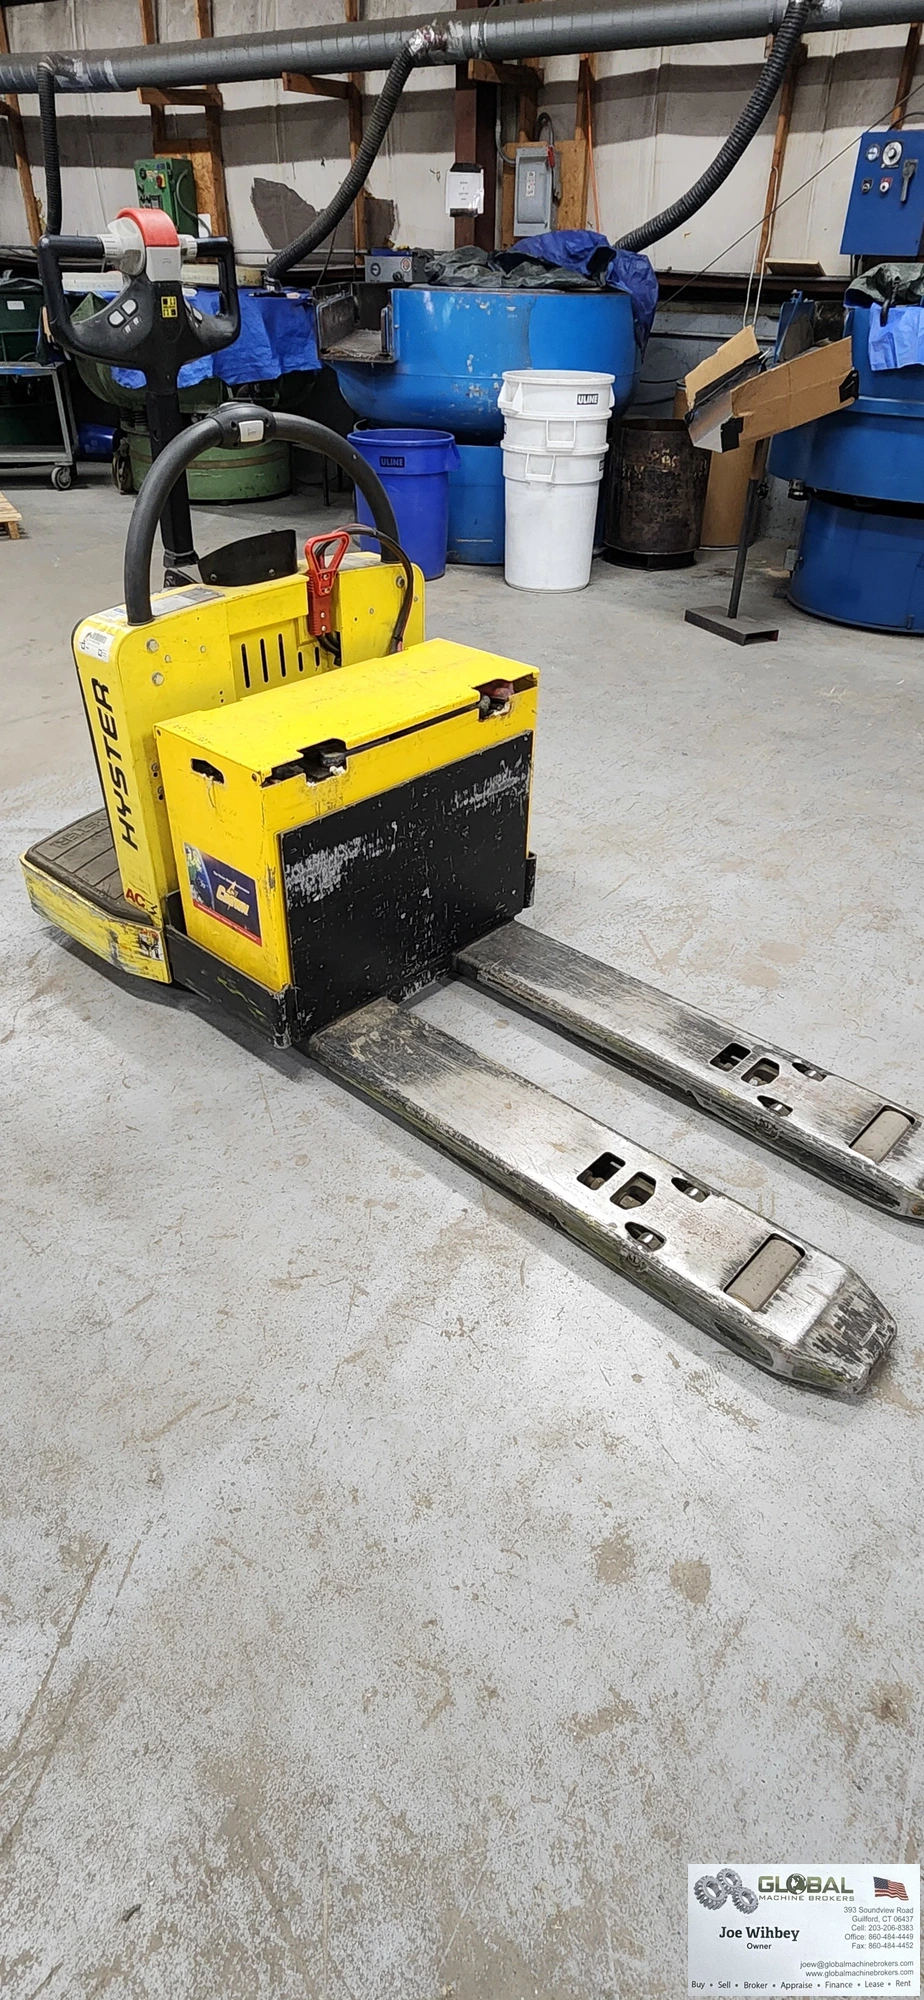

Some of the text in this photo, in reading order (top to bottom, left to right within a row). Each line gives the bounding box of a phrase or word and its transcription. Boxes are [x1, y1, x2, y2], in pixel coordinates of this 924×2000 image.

[577, 394, 598, 405] ULINE
[381, 457, 403, 467] ULINE
[92, 677, 138, 850] HYSTER
[49, 818, 109, 849] YSTER
